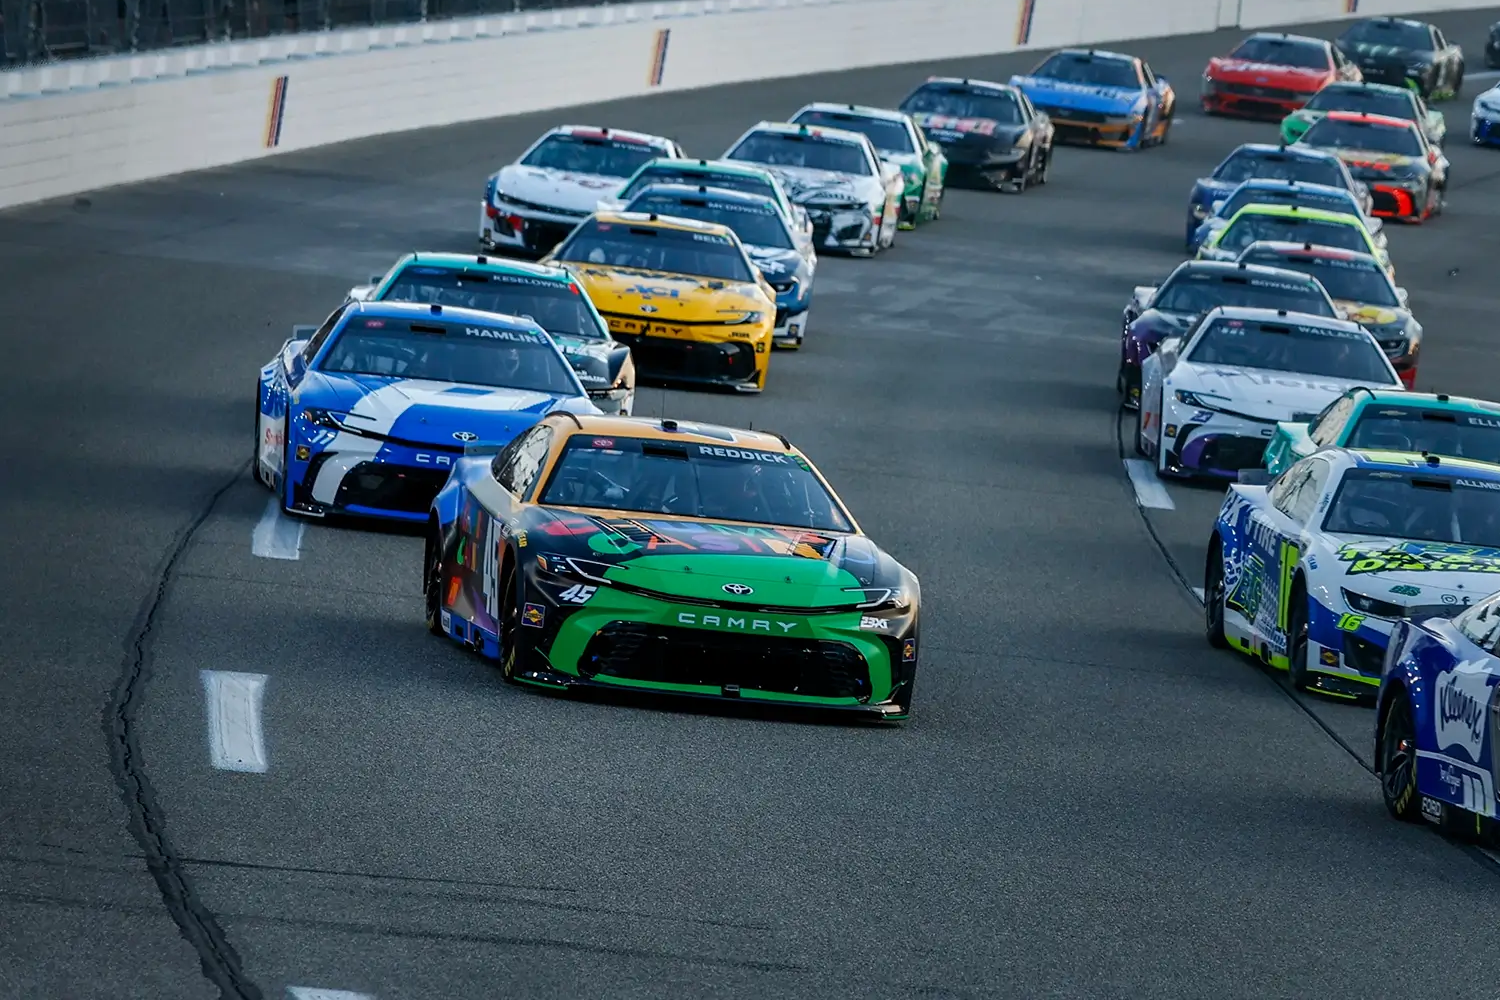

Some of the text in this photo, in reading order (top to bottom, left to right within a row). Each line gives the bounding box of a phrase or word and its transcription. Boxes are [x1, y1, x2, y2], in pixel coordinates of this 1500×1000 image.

[493, 274, 570, 289] KESELOWSK
[464, 326, 541, 345] HAMLIN
[698, 444, 790, 466] REDDICK
[558, 583, 598, 604] 45
[678, 612, 797, 634] CAMRY
[1336, 612, 1367, 633] 16
